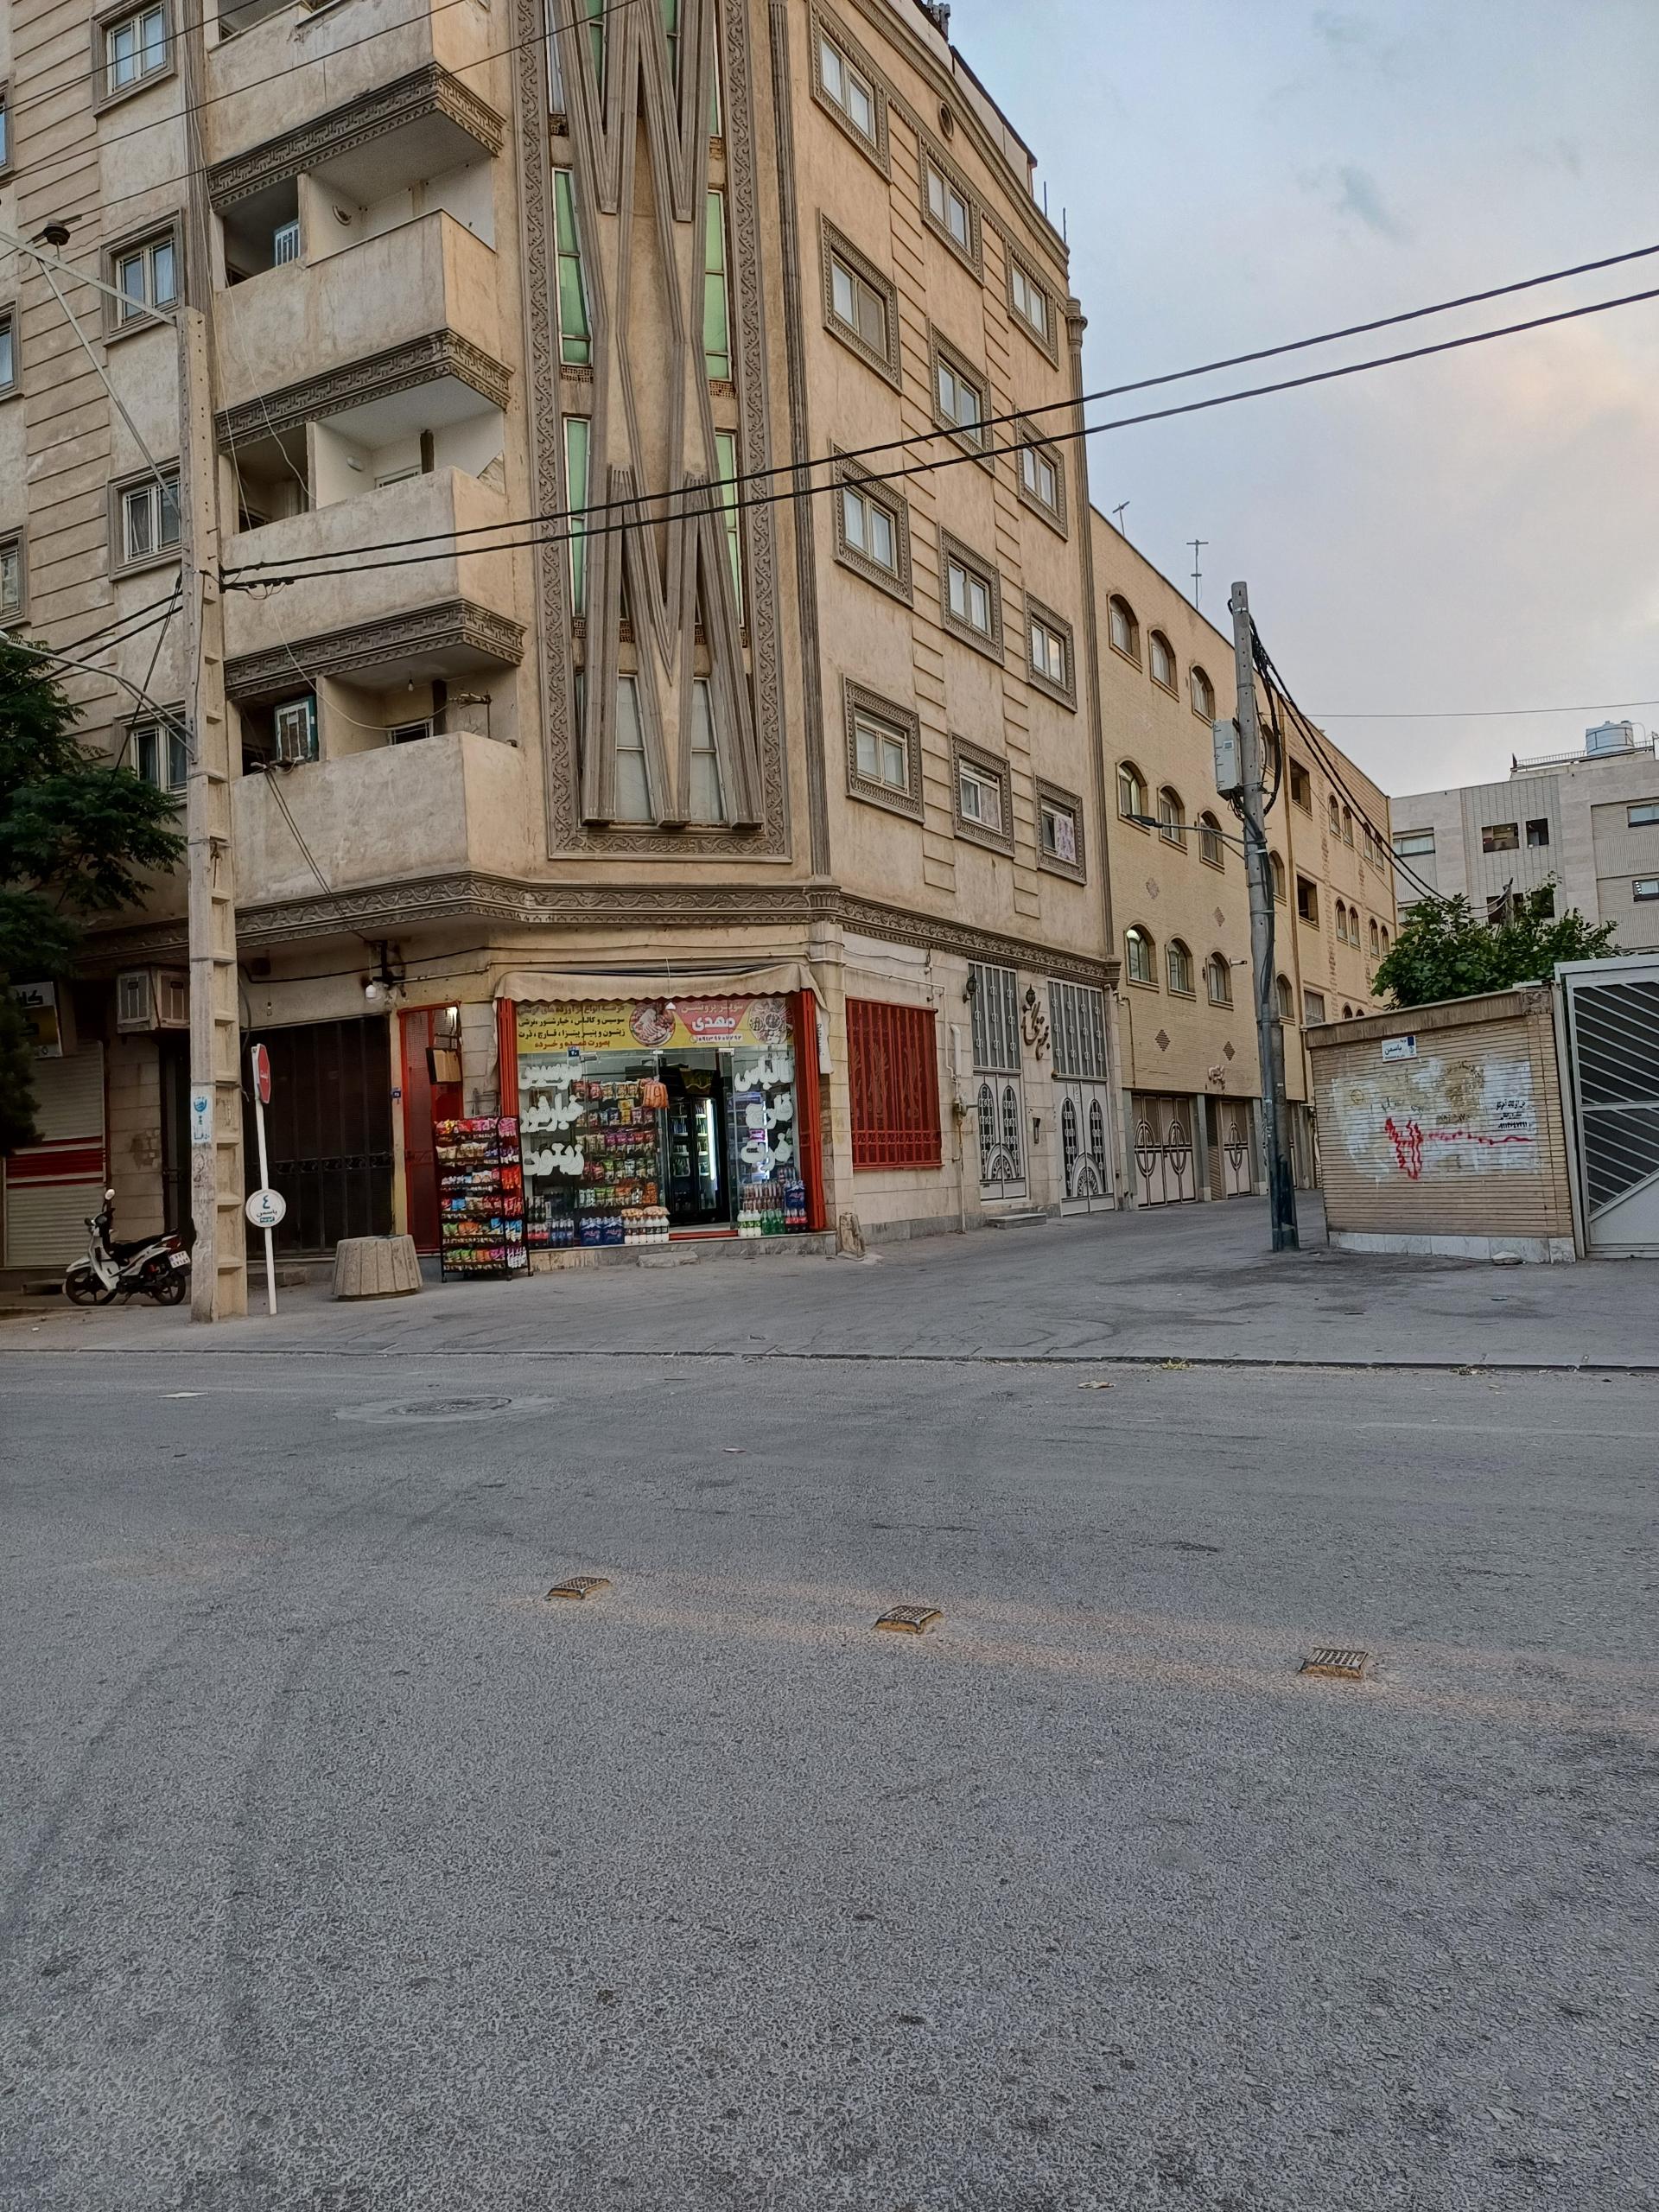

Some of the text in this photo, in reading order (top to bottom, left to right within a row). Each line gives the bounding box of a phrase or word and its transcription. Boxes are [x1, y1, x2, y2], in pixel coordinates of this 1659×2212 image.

[719, 1002, 743, 1013] سوپر
[540, 1017, 569, 1027] خیارشور
[575, 1016, 595, 1026] کالباس
[692, 1014, 735, 1031] مهدی
[518, 1029, 533, 1039] ذرت
[537, 1029, 557, 1039] قارچ
[602, 1028, 626, 1037] زیتون
[518, 1064, 582, 1090] سوسیس
[734, 1055, 795, 1091] کالباس
[520, 1093, 584, 1133] خیارشور
[746, 1093, 793, 1129] قارچ
[522, 1143, 584, 1176] زیتون
